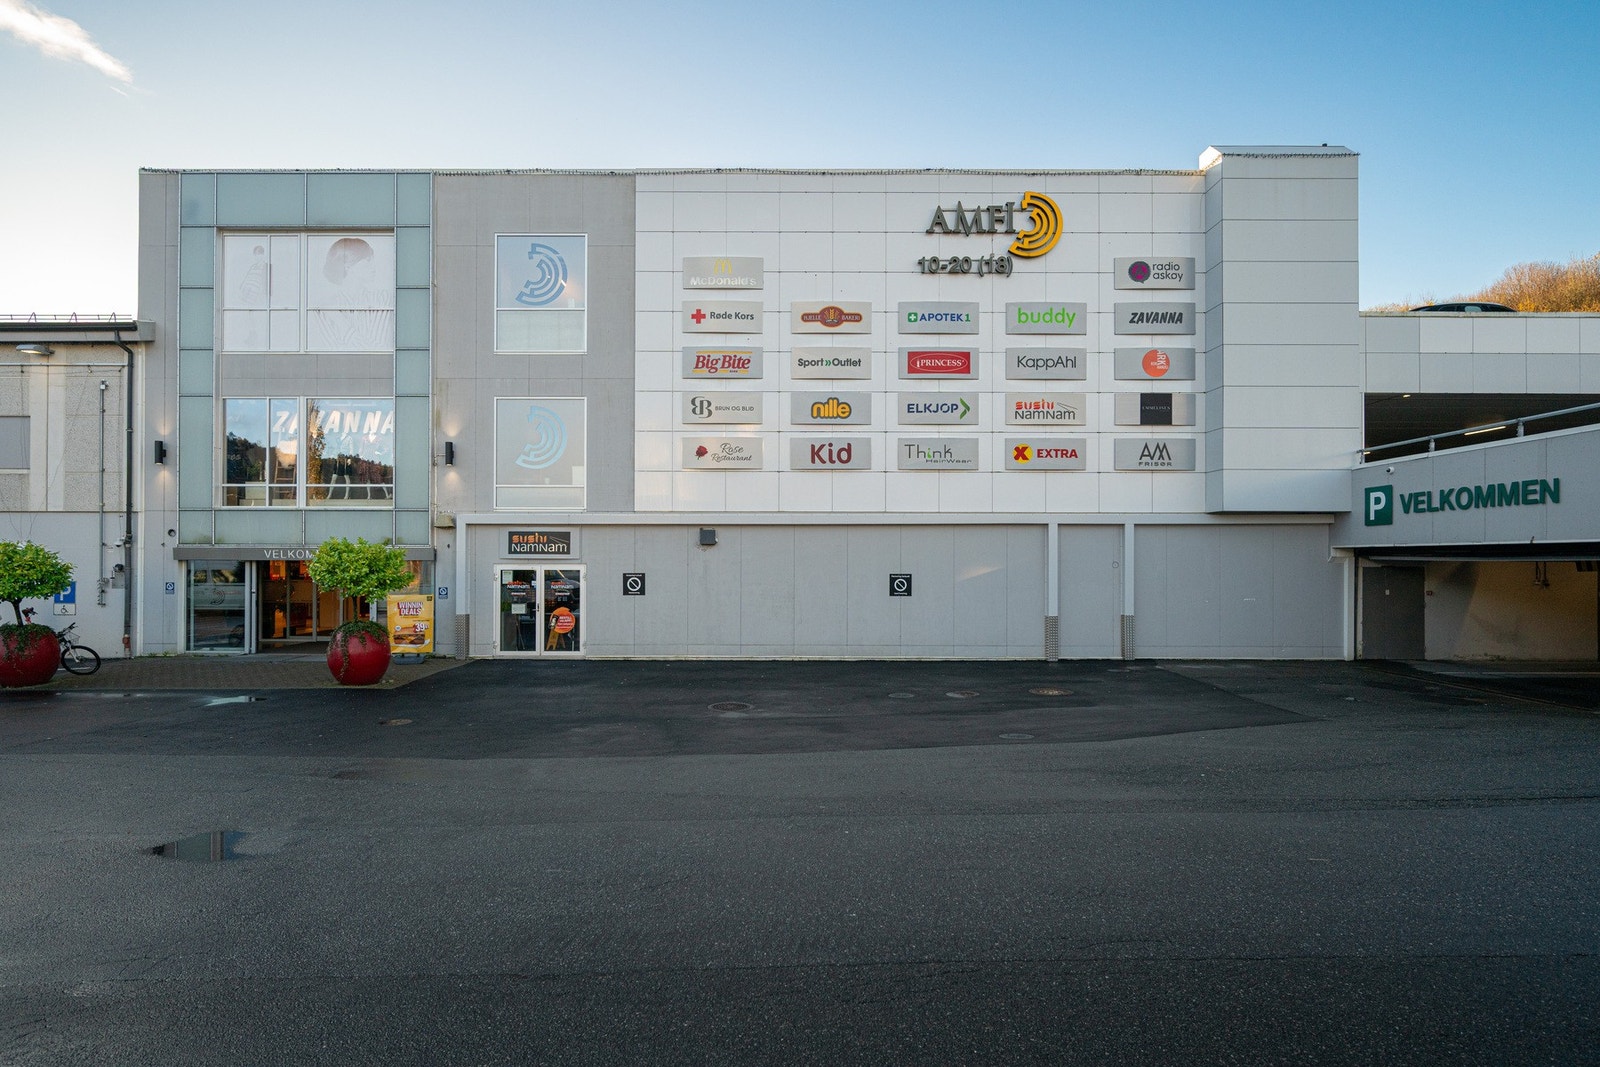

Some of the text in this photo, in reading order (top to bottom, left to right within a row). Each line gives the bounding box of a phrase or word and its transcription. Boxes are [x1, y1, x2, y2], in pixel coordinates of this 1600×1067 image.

[926, 200, 1016, 237] AMFI
[918, 256, 1013, 277] 10-20 (18)
[1152, 262, 1180, 271] radio
[709, 310, 755, 321] Røde Kors
[1017, 307, 1076, 329] buddy
[1128, 311, 1184, 324] ZAVANNA
[693, 354, 751, 374] Big Bite
[1017, 355, 1077, 371] KappAhl
[715, 404, 730, 412] BRUN
[811, 397, 852, 419] nille
[720, 442, 744, 456] Rose
[810, 442, 852, 464] Kid
[904, 444, 952, 459] Think
[1037, 448, 1078, 459] EXTRA
[710, 453, 752, 463] Restaurant
[1369, 478, 1560, 521] P VELKOMMEN
[512, 532, 547, 544] sushi
[264, 549, 319, 559] VELKOM
